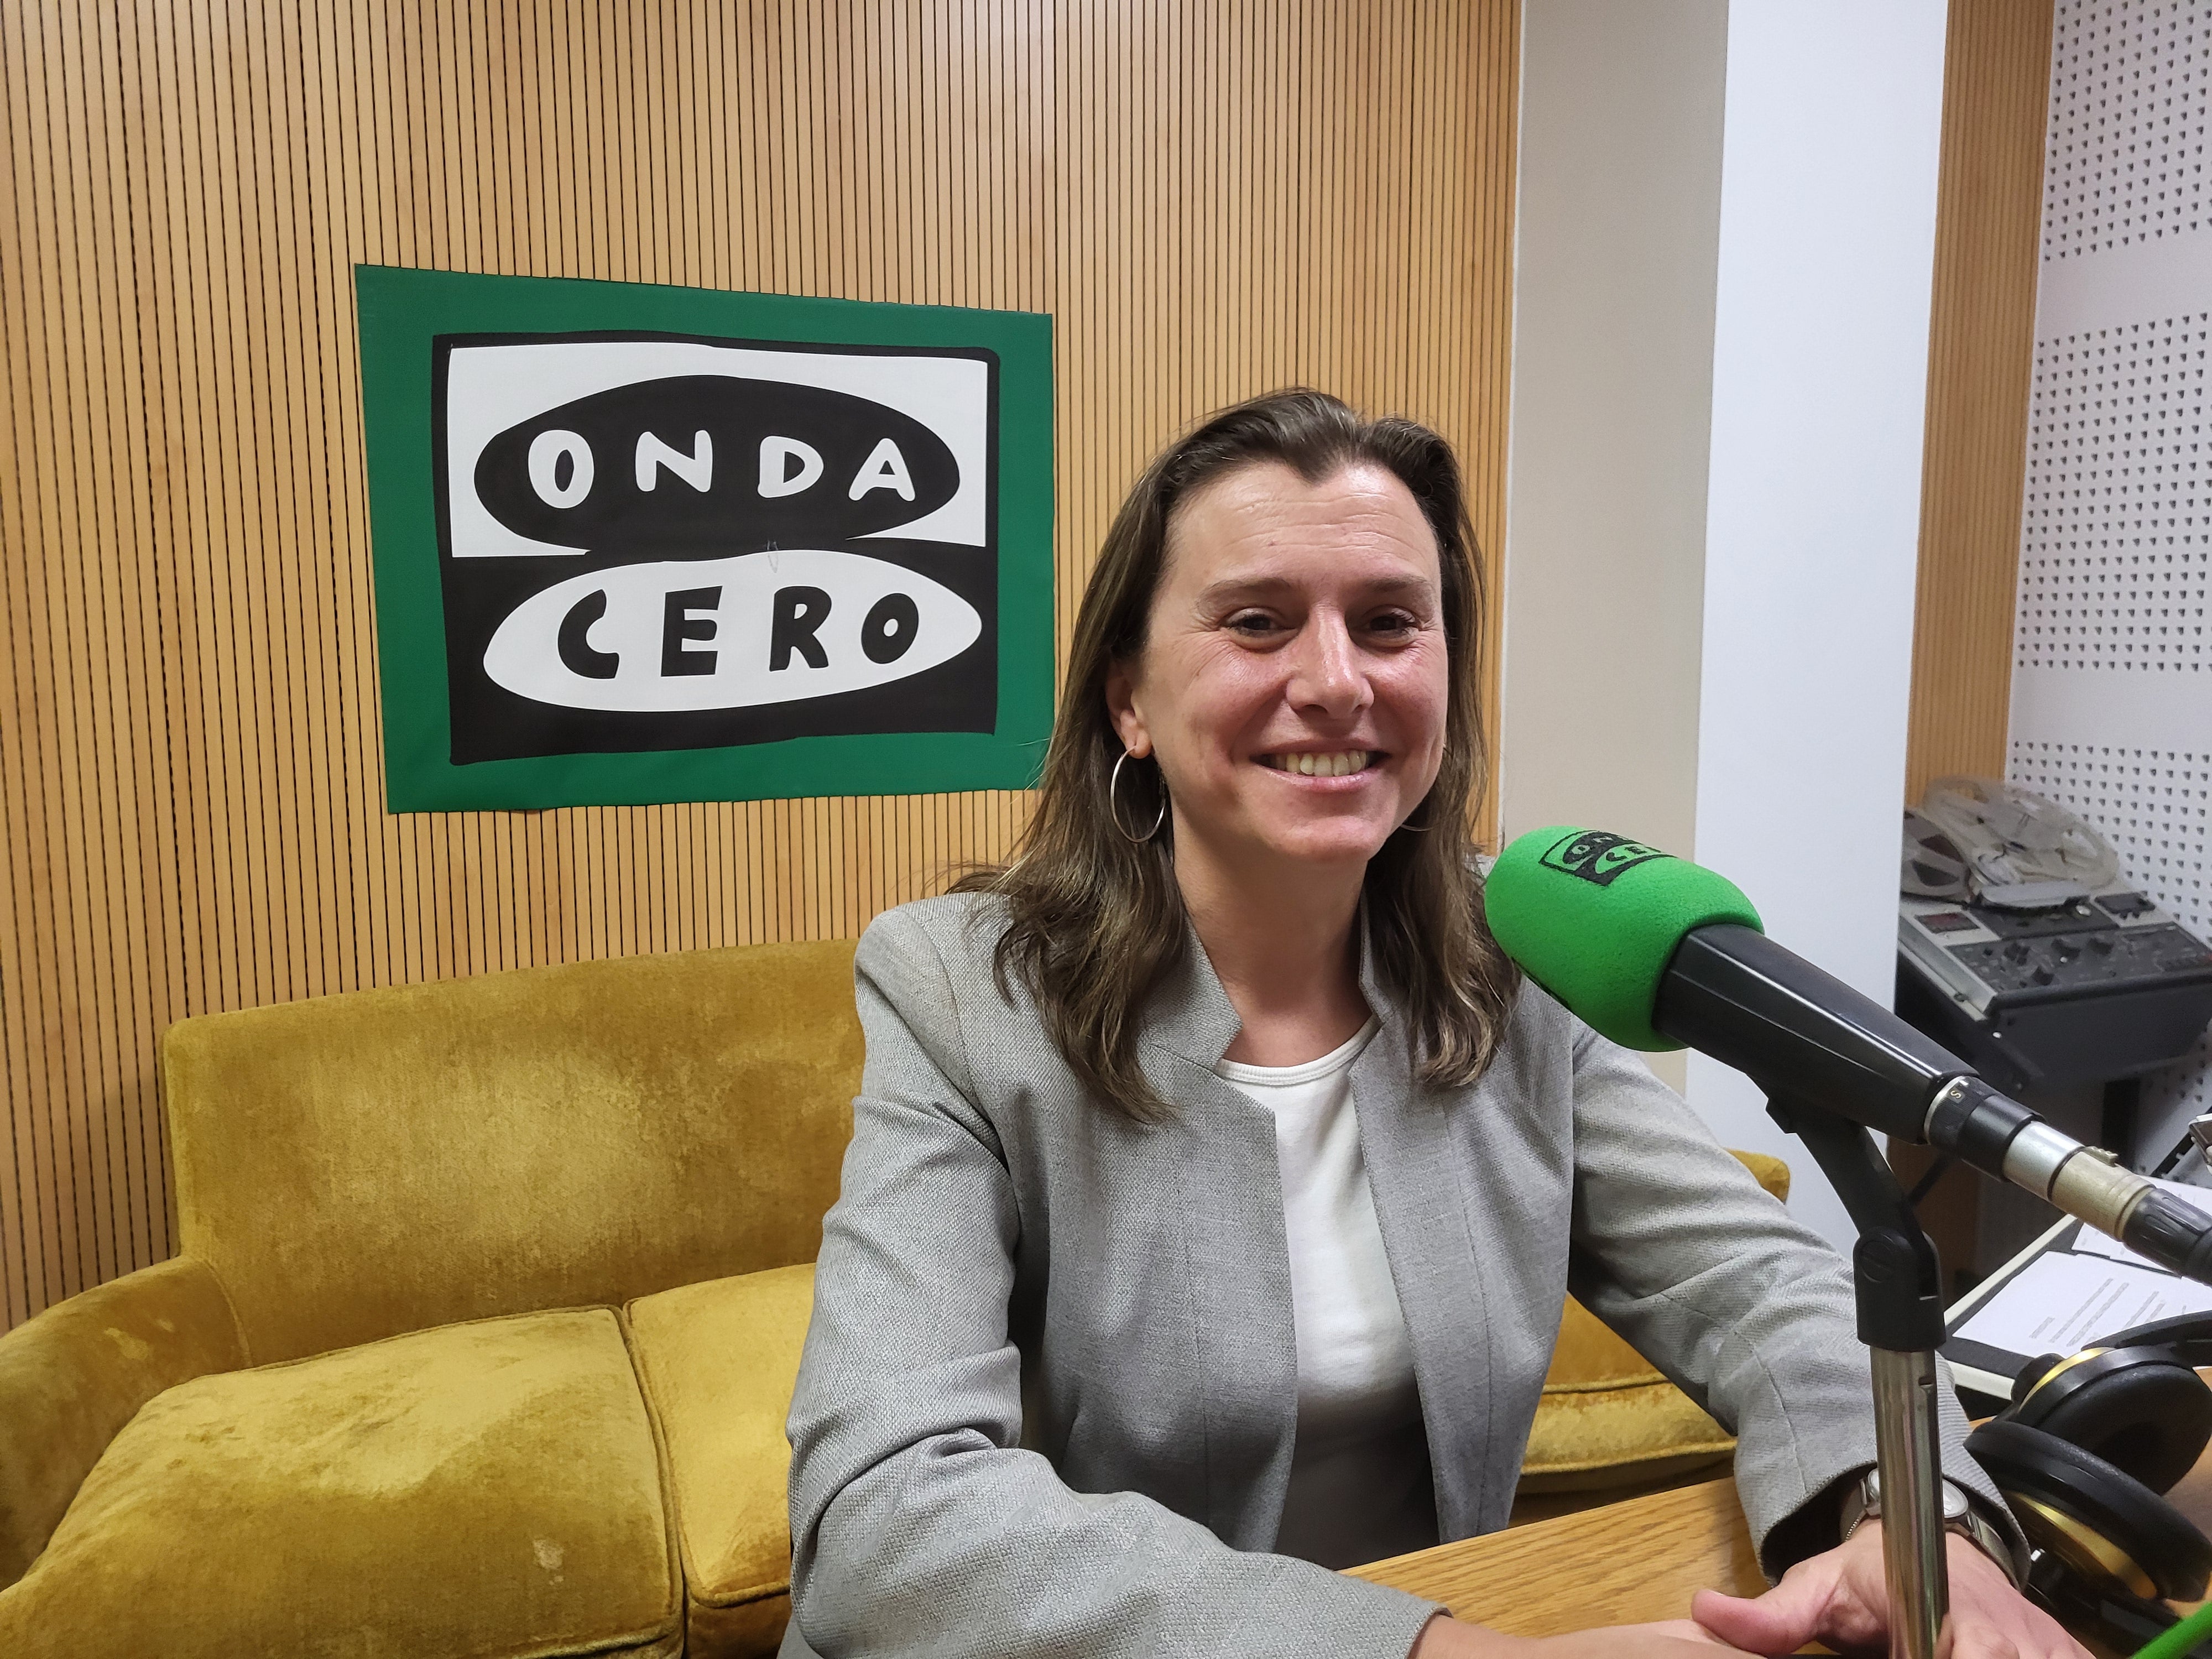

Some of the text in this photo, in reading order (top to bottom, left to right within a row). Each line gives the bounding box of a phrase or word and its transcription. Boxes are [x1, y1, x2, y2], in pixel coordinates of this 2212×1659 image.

[528, 429, 916, 509] ONDA
[557, 586, 919, 680] CERO
[1571, 836, 1613, 855] ON
[1605, 846, 1647, 862] CE
